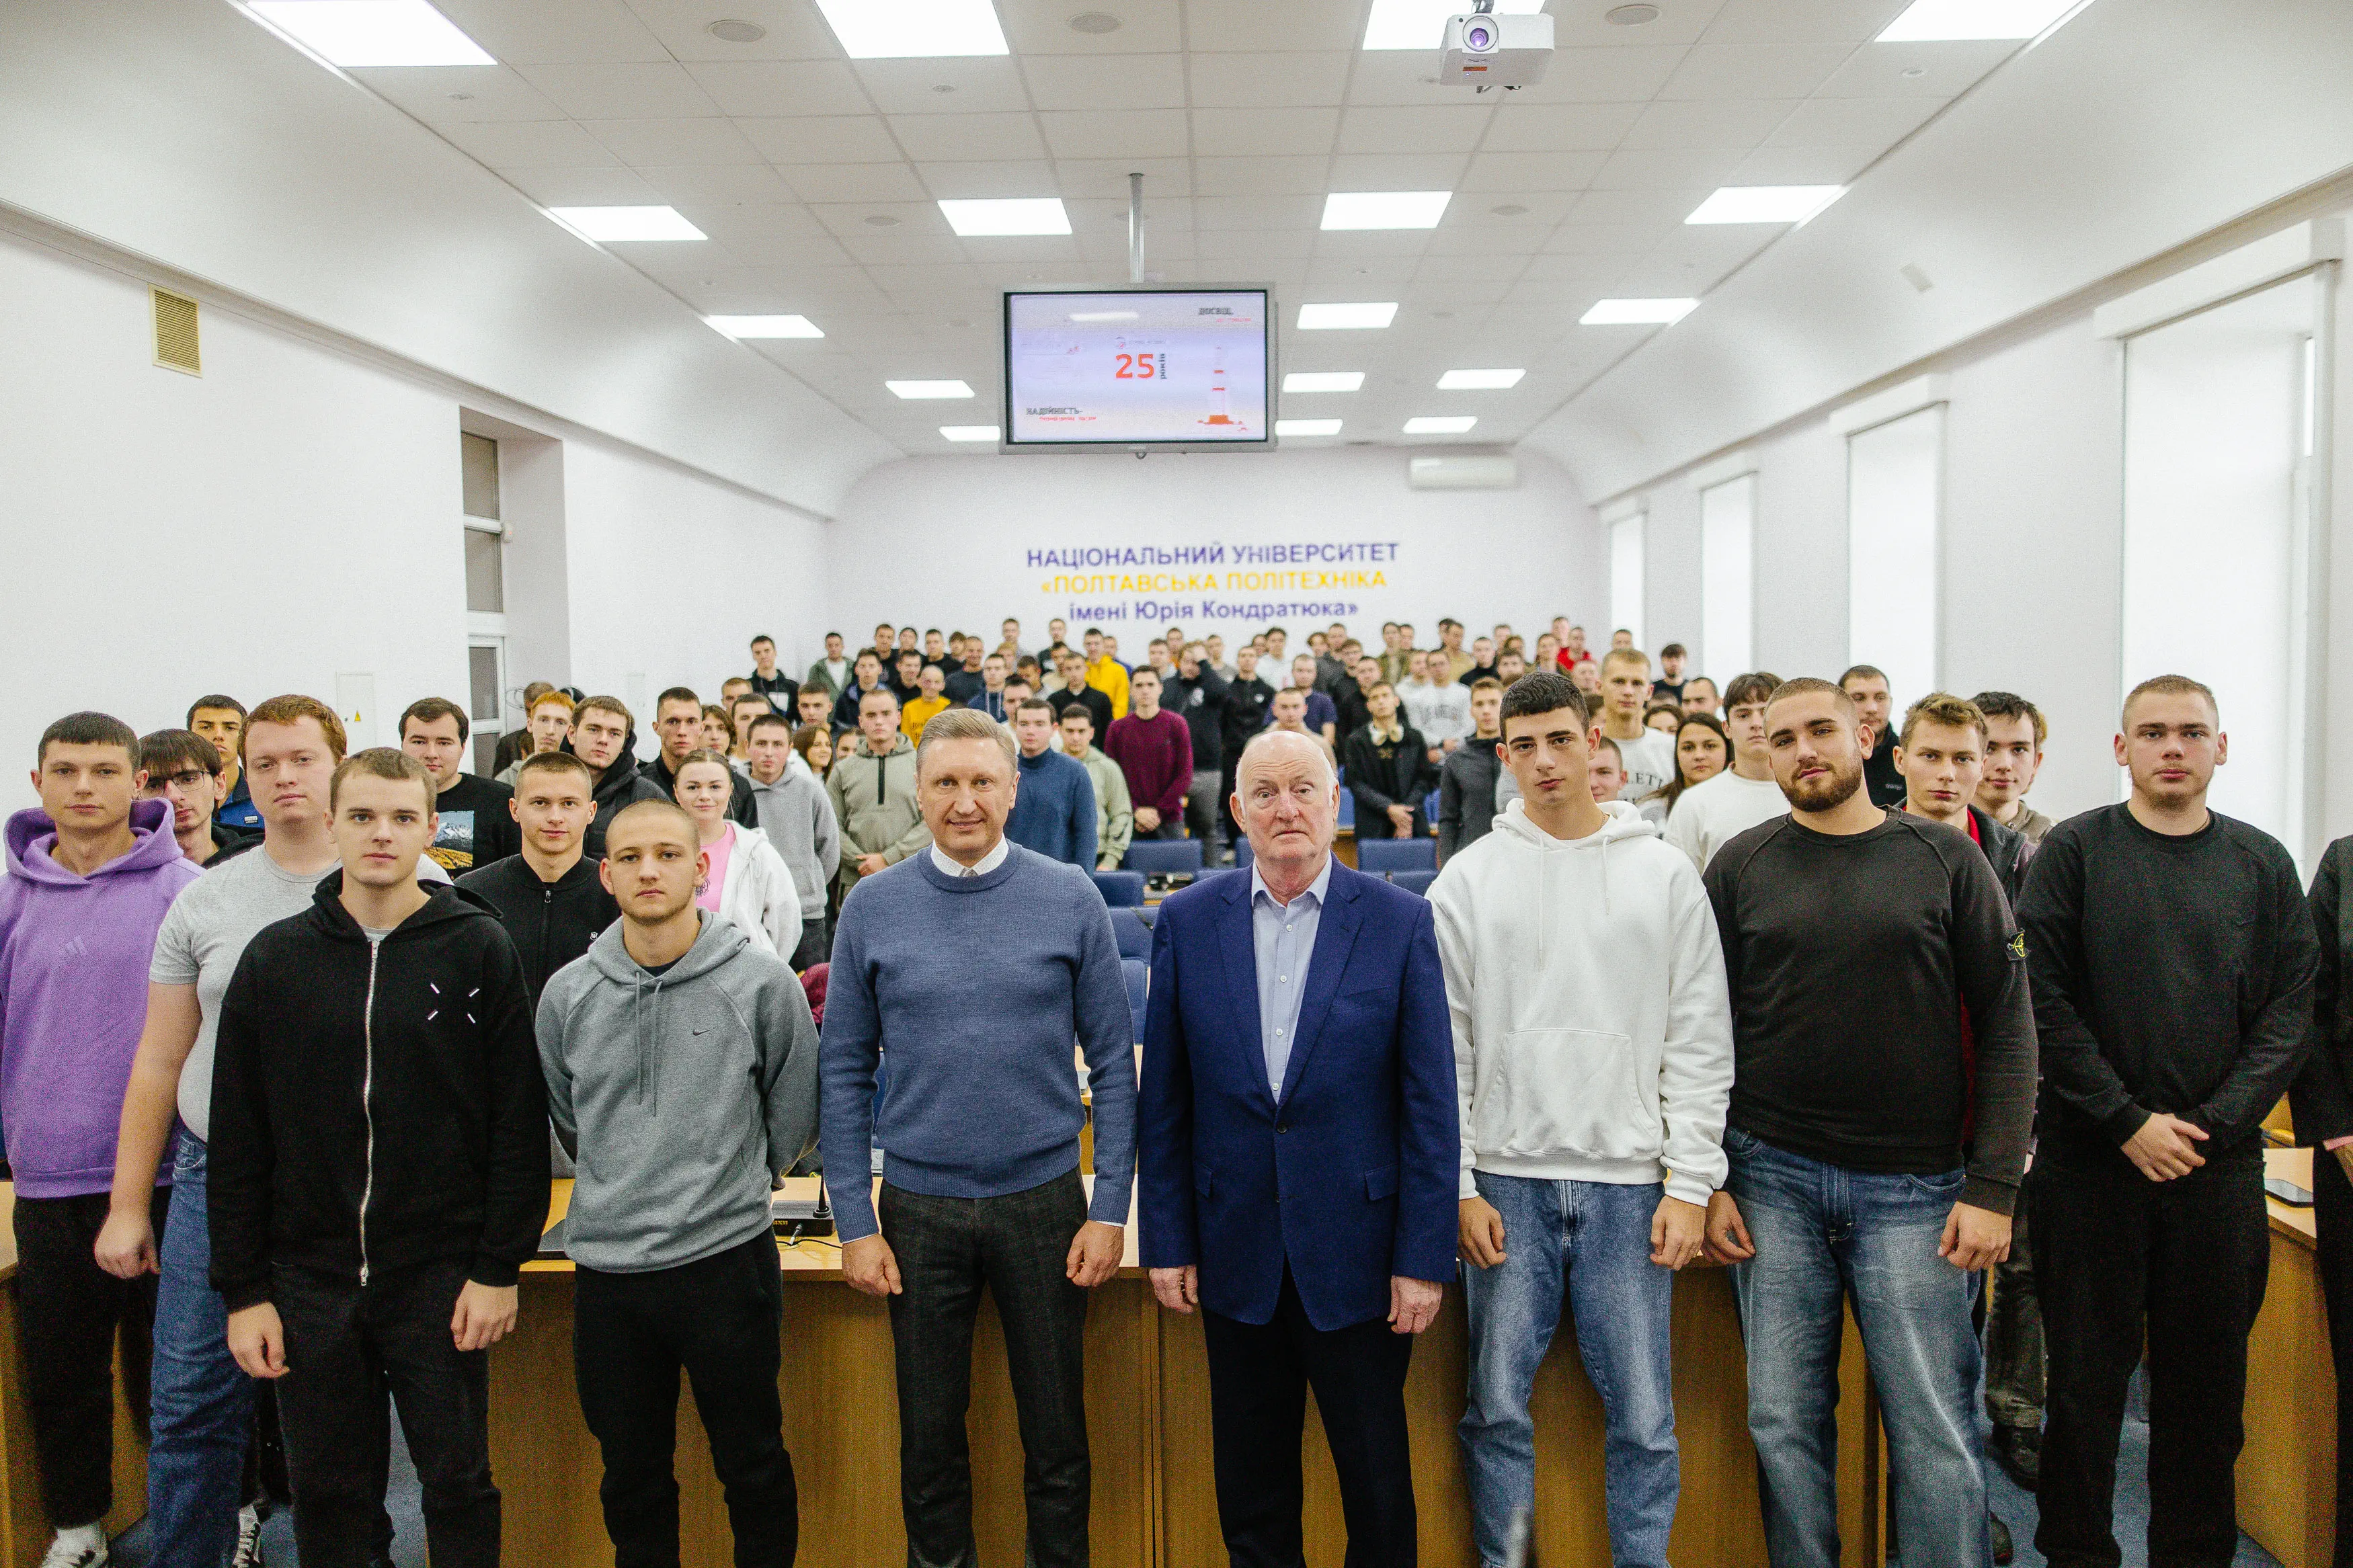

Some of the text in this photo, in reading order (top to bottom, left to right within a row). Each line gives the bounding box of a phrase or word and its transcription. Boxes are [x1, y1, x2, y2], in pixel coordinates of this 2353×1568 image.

[1115, 354, 1154, 378] 25
[1158, 353, 1167, 380] років
[1027, 540, 1399, 570] НАЦІОНАЛЬНИЙ УНІВЕРСИТЕТ
[1041, 570, 1388, 594] «ПОЛТАВСЬКА ПОЛІТЕХНІКА
[1070, 601, 1359, 623] імені Юрія Кондратюка»
